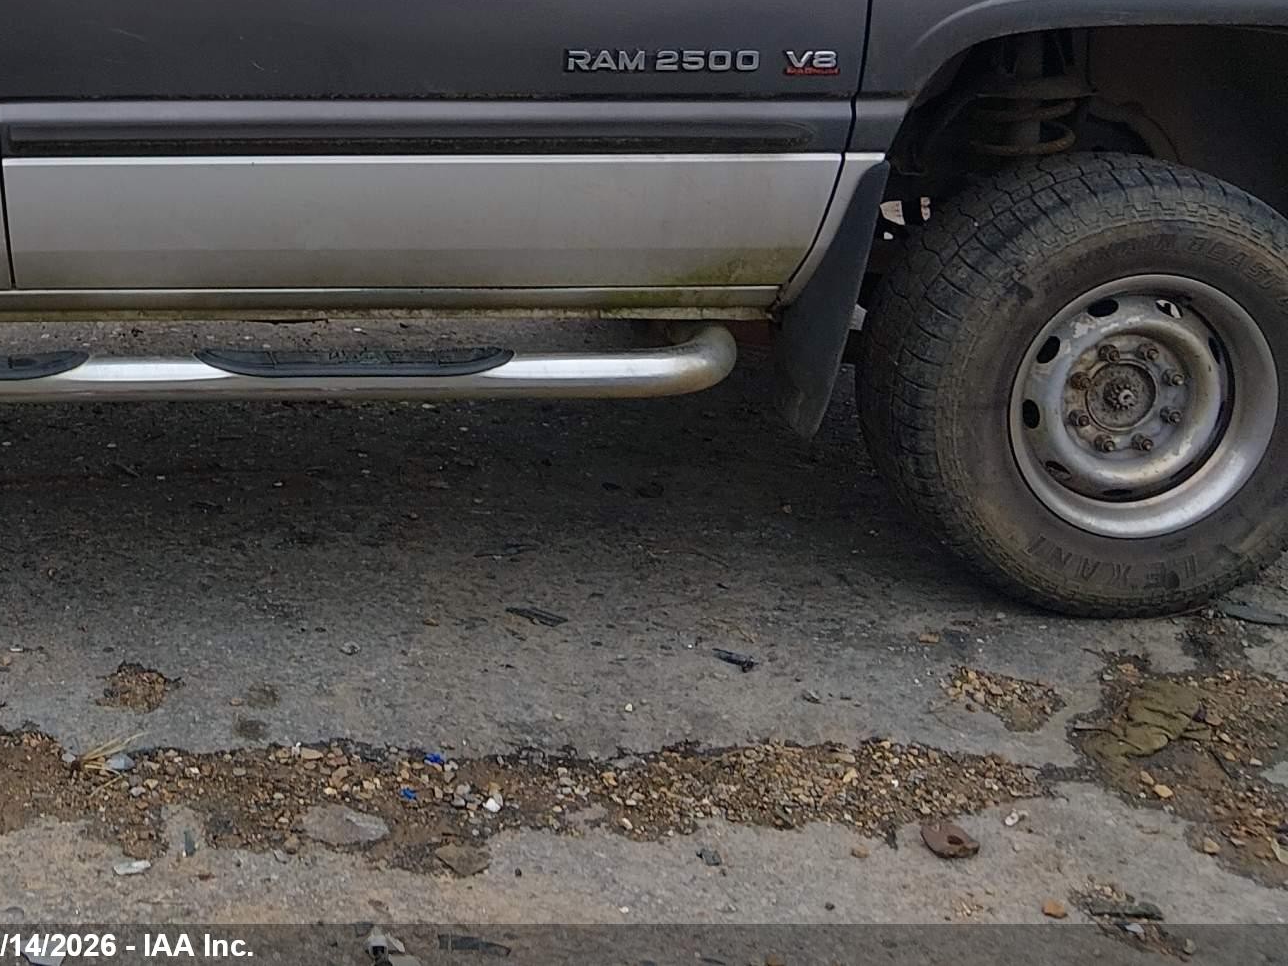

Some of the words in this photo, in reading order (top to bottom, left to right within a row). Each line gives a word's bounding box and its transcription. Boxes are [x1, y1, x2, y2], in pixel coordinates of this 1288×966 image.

[567, 49, 646, 72] RAM
[655, 49, 761, 72] 2500
[785, 50, 838, 68] V8
